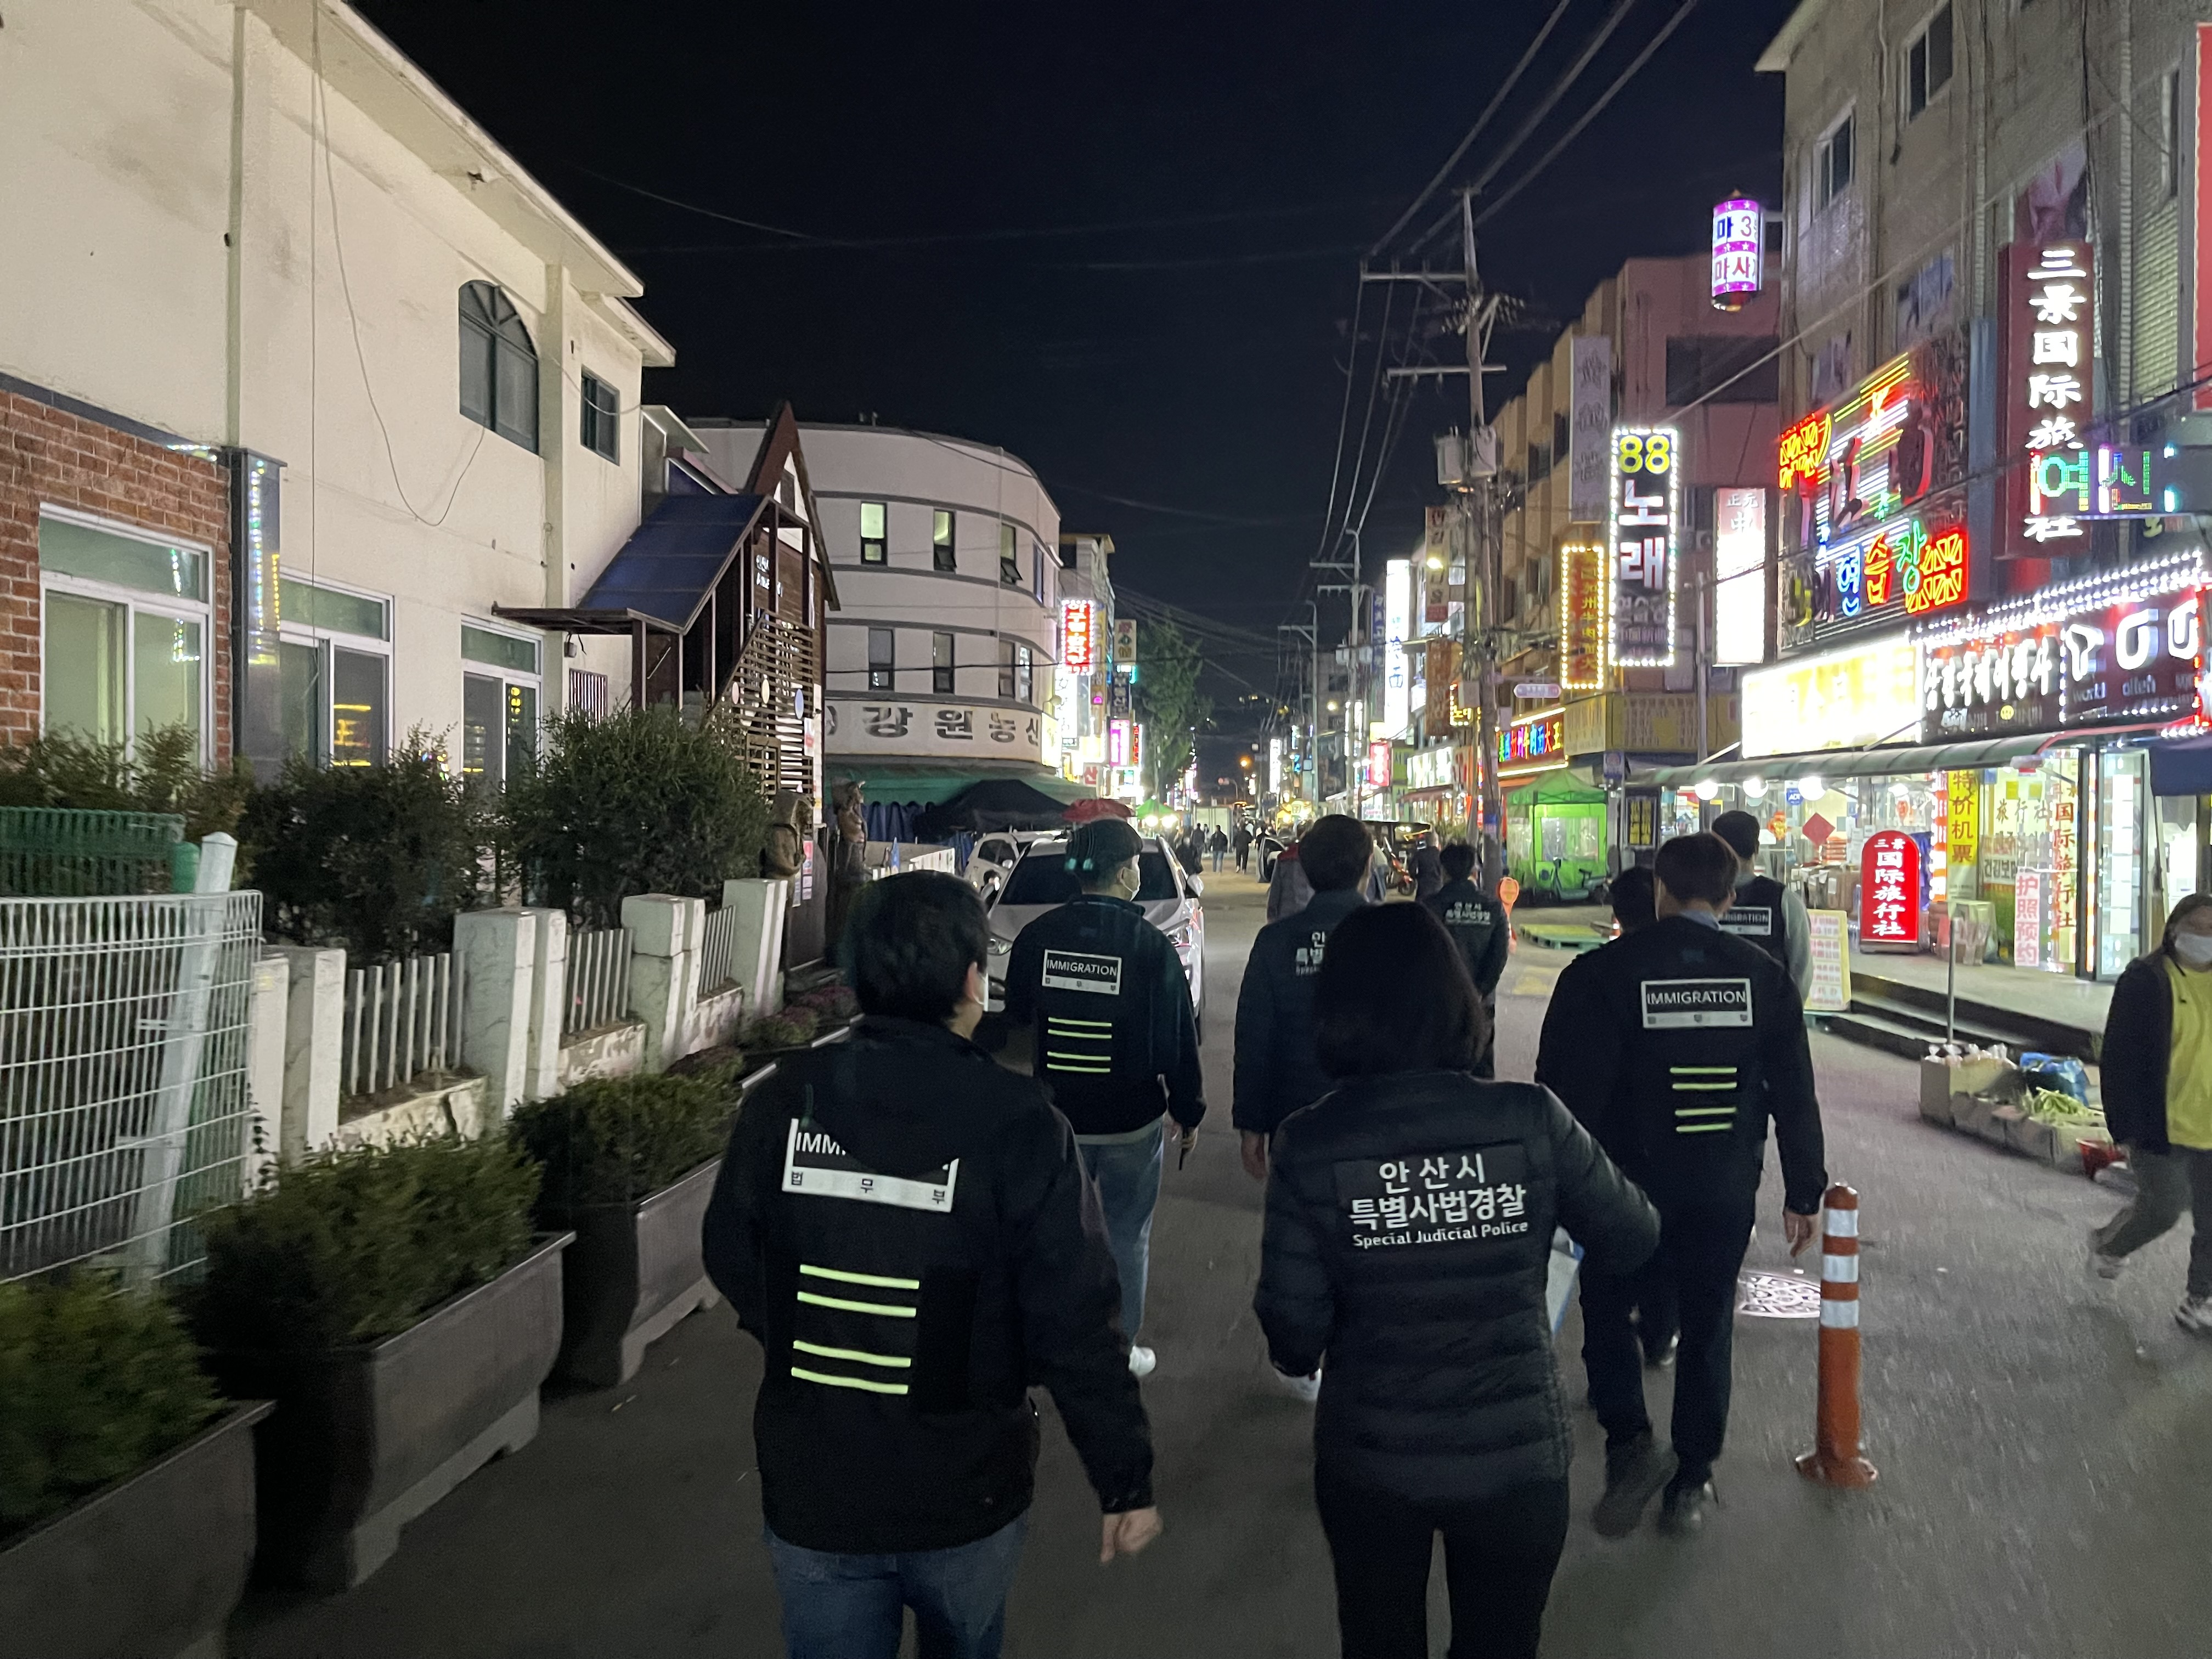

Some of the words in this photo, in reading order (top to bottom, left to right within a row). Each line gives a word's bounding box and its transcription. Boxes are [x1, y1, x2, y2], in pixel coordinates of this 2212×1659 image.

[1619, 435, 1670, 475] 88
[1618, 479, 1669, 589] 노래
[1952, 770, 1974, 863] 特价机票
[1874, 838, 1906, 850] 三景
[1872, 851, 1906, 936] 国际旅行社
[2017, 875, 2039, 965] 护照预约
[1047, 959, 1117, 977] IMMIGRATION
[1647, 990, 1746, 1005] IMMIGRATION
[1348, 1183, 1527, 1231] 특별사법경찰
[1352, 1231, 1412, 1250] Special
[1415, 1225, 1479, 1244] Judicial
[1481, 1221, 1528, 1238] Police
